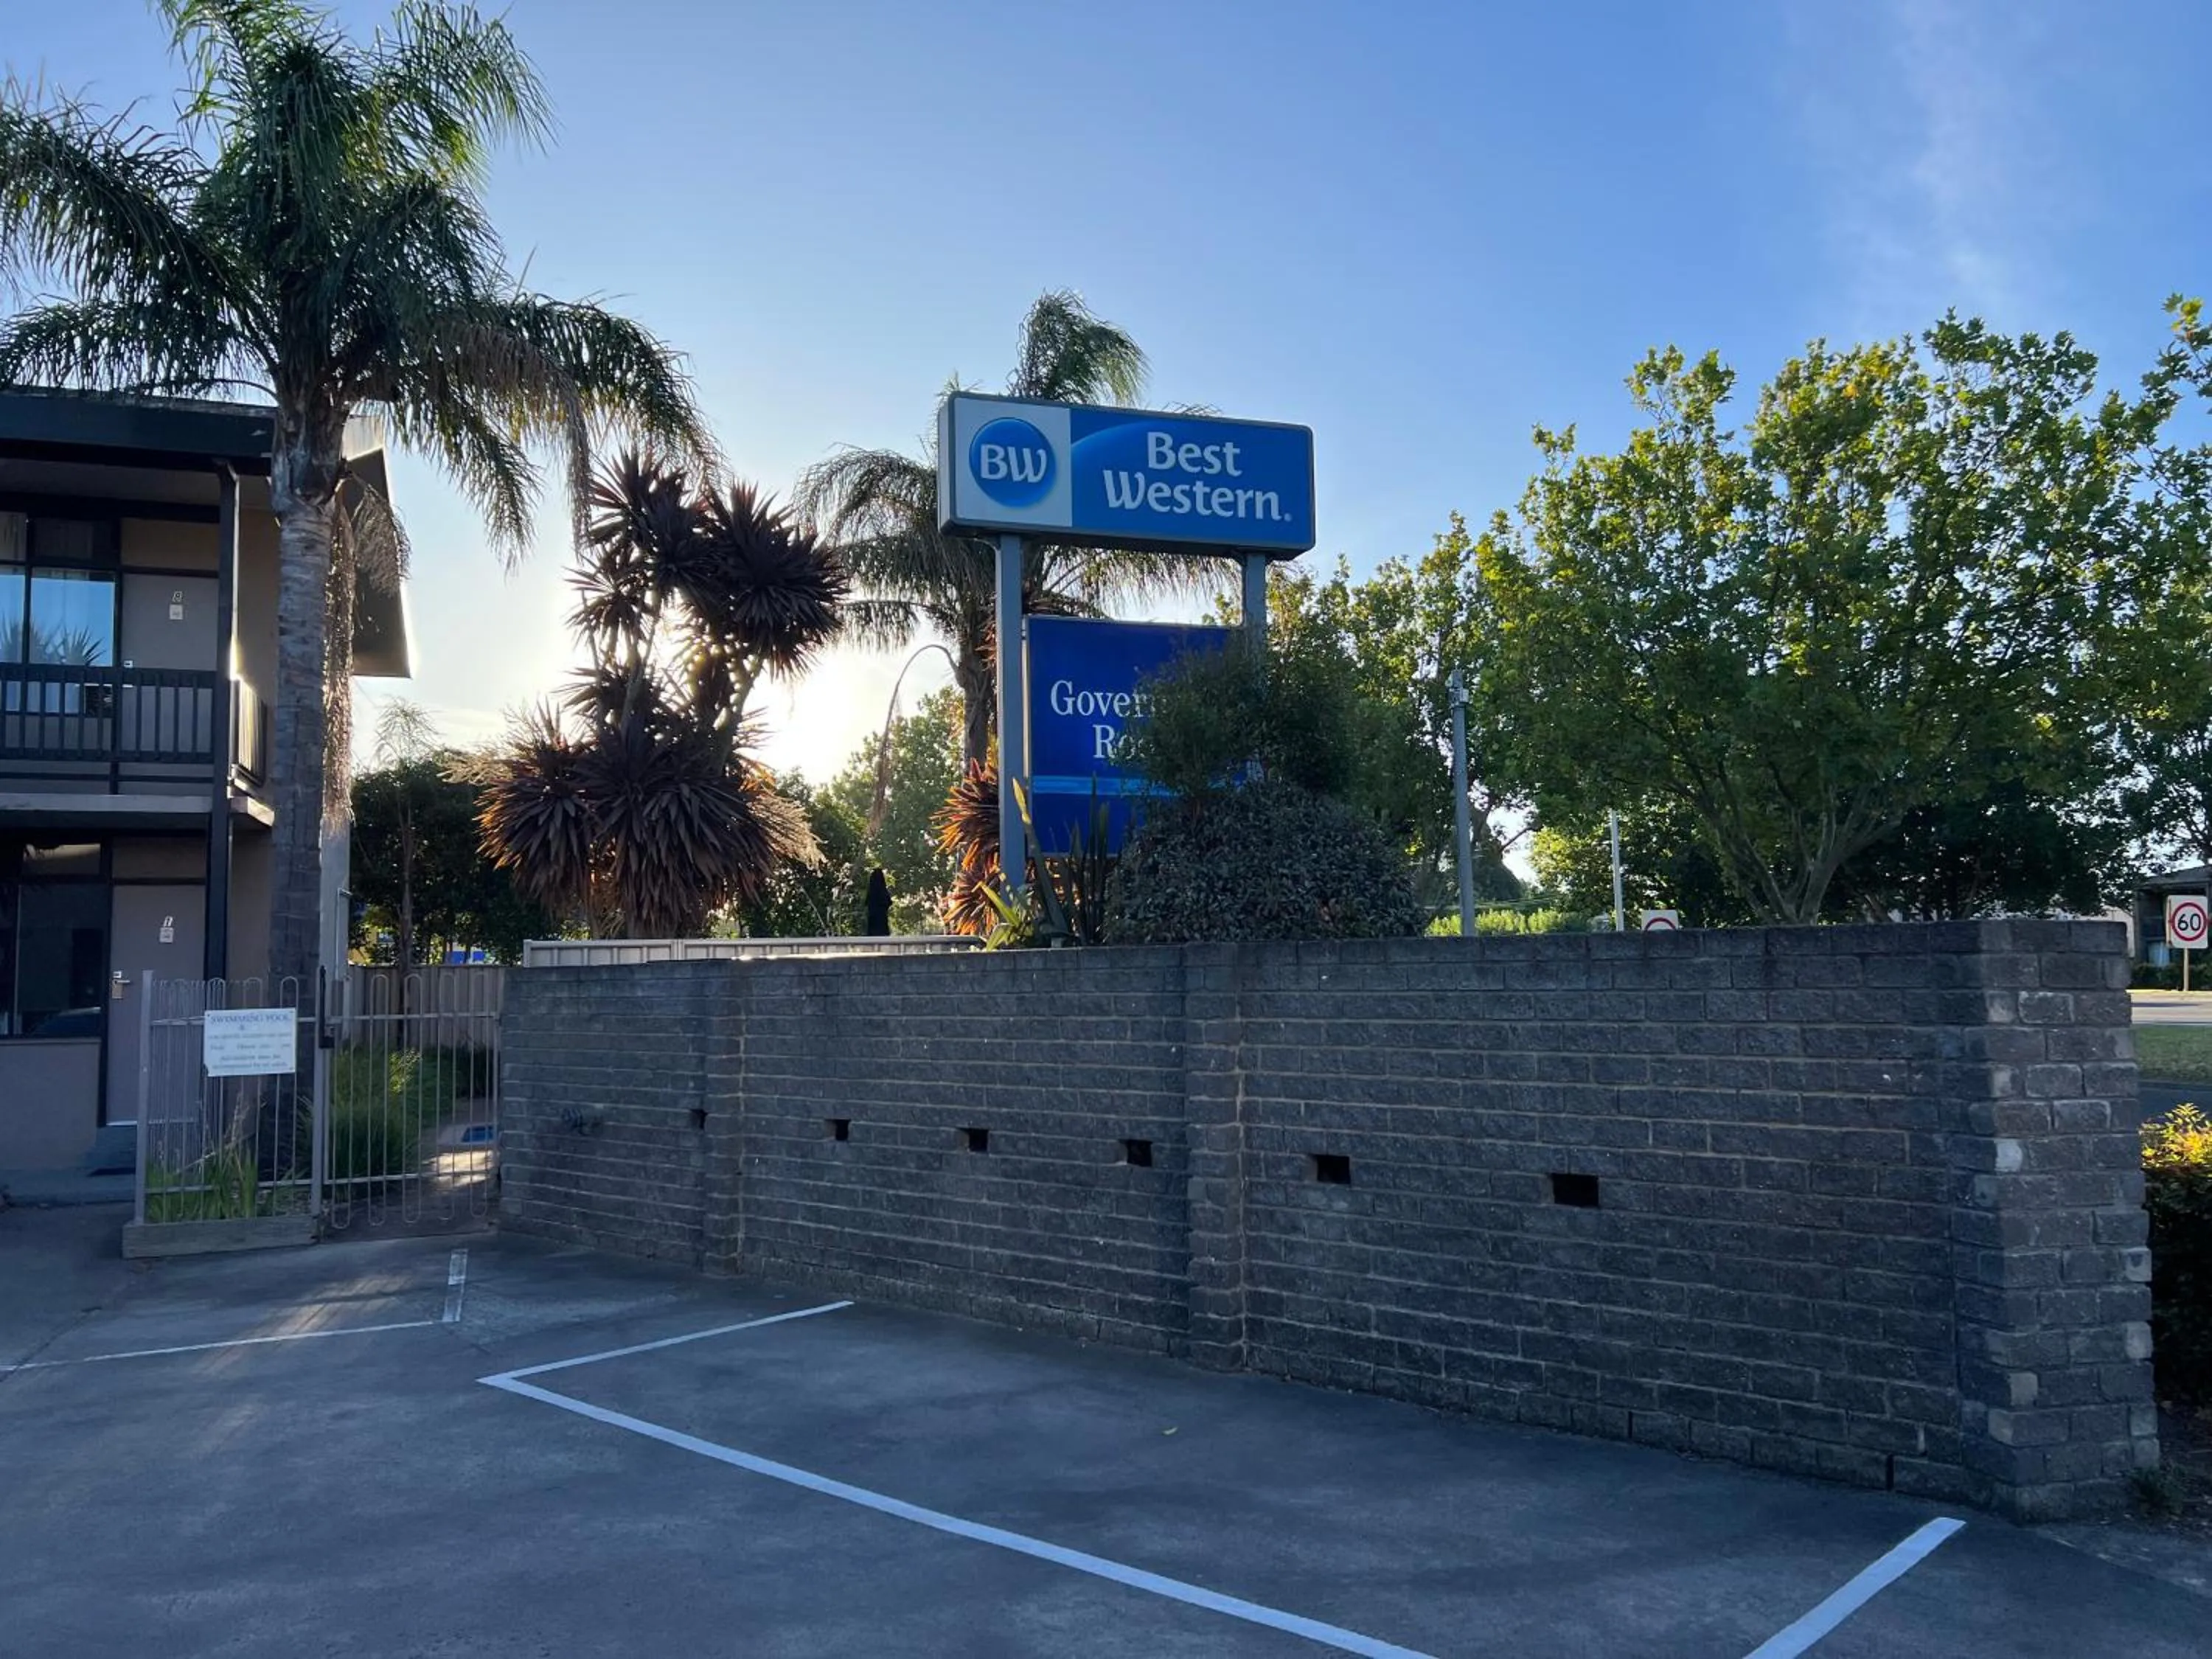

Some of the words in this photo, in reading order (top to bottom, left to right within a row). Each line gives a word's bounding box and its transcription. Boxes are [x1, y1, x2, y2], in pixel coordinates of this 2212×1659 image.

[981, 444, 1047, 483] BW
[1147, 431, 1242, 477] Best
[2177, 913, 2201, 931] 60
